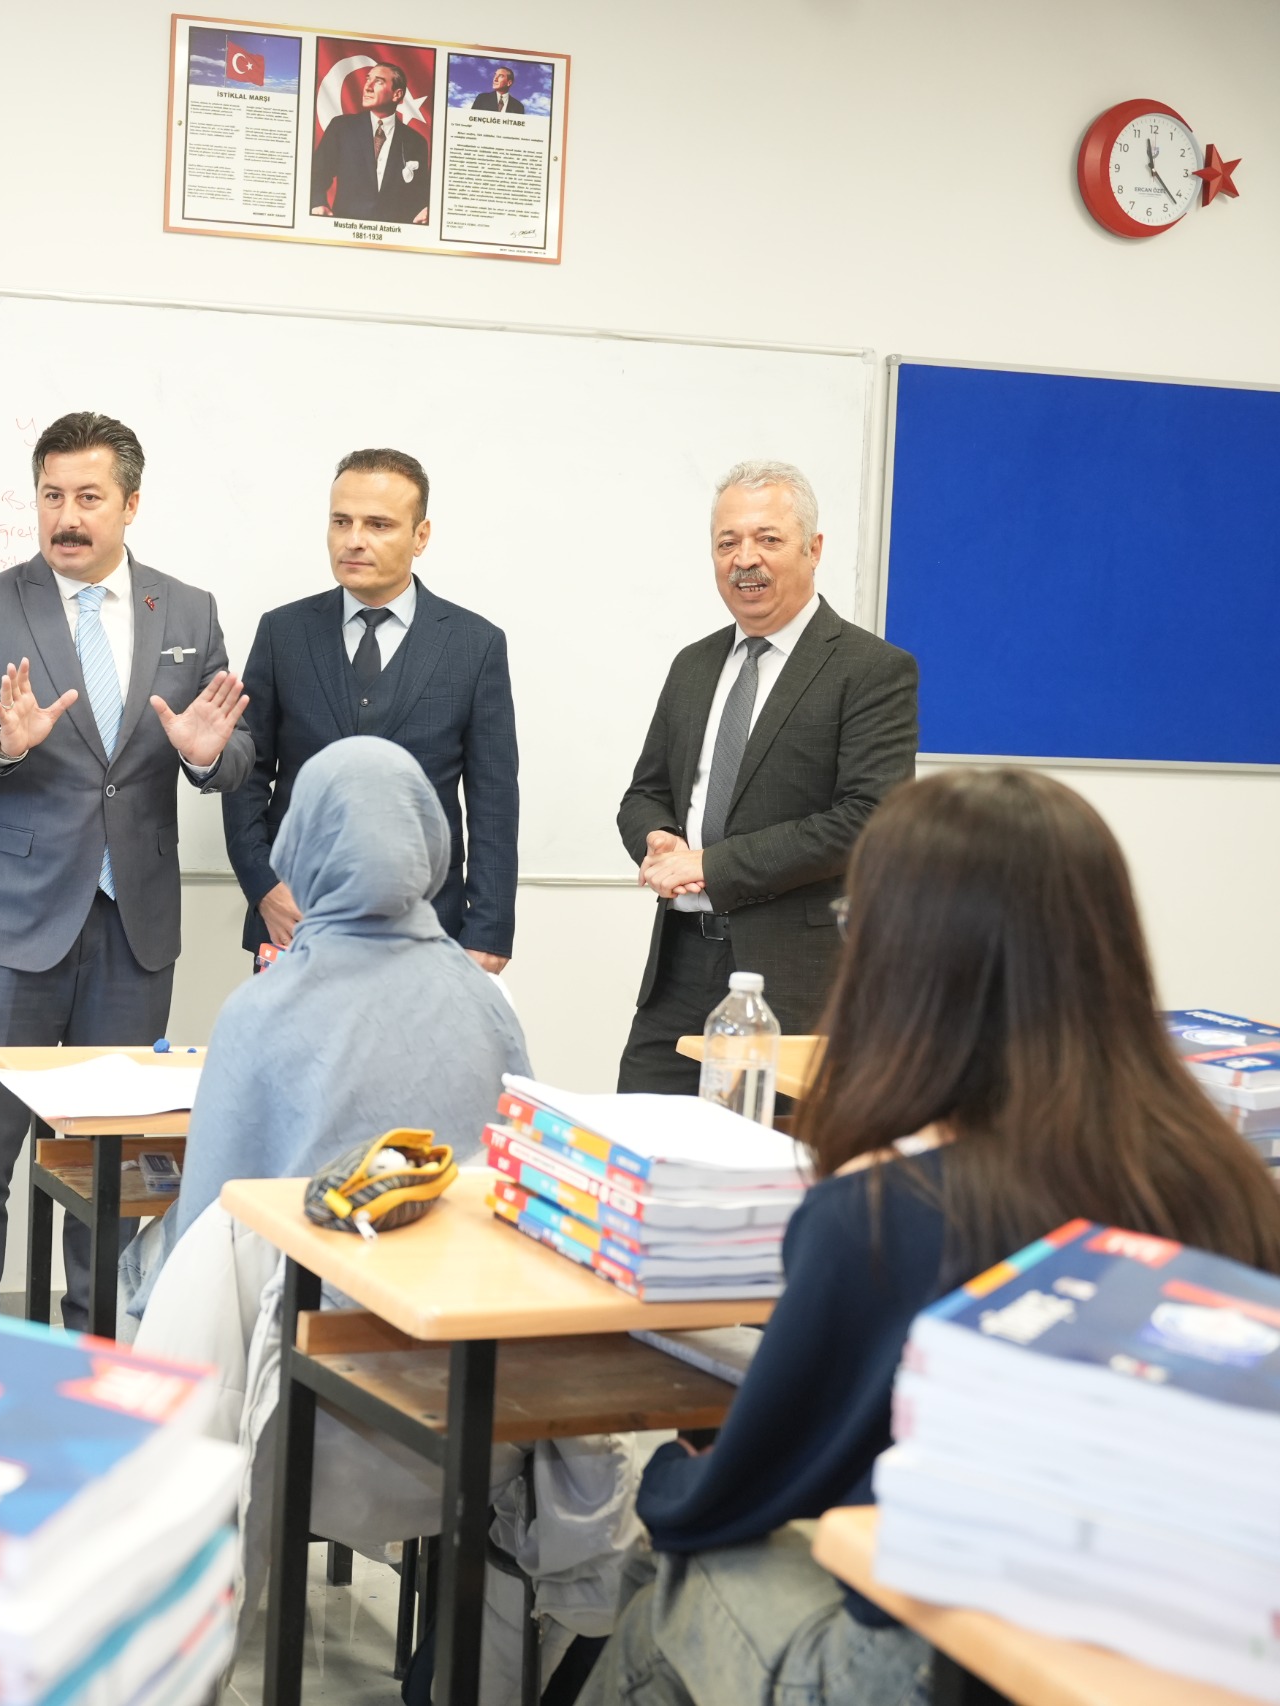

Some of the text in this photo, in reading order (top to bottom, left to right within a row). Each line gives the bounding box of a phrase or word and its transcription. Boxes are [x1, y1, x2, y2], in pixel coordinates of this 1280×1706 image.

[217, 90, 270, 103] İSTİKLAL MARŞI
[468, 115, 501, 125] GENÇLİĞE
[502, 119, 526, 127] HİTABE
[1133, 129, 1141, 139] 11
[1150, 124, 1159, 135] 12
[1119, 143, 1130, 153] 10
[1179, 148, 1186, 158] 2
[1114, 163, 1121, 173] 9
[1182, 168, 1189, 178] 3
[1117, 185, 1124, 195] 8
[1176, 189, 1182, 198] 4
[1129, 200, 1136, 211] 7
[1162, 203, 1169, 213] 5
[1146, 208, 1152, 217] 6
[333, 220, 402, 233] Mustafa Kemal Atatürk
[352, 231, 383, 241] 1881-1938
[15, 417, 37, 447] Y
